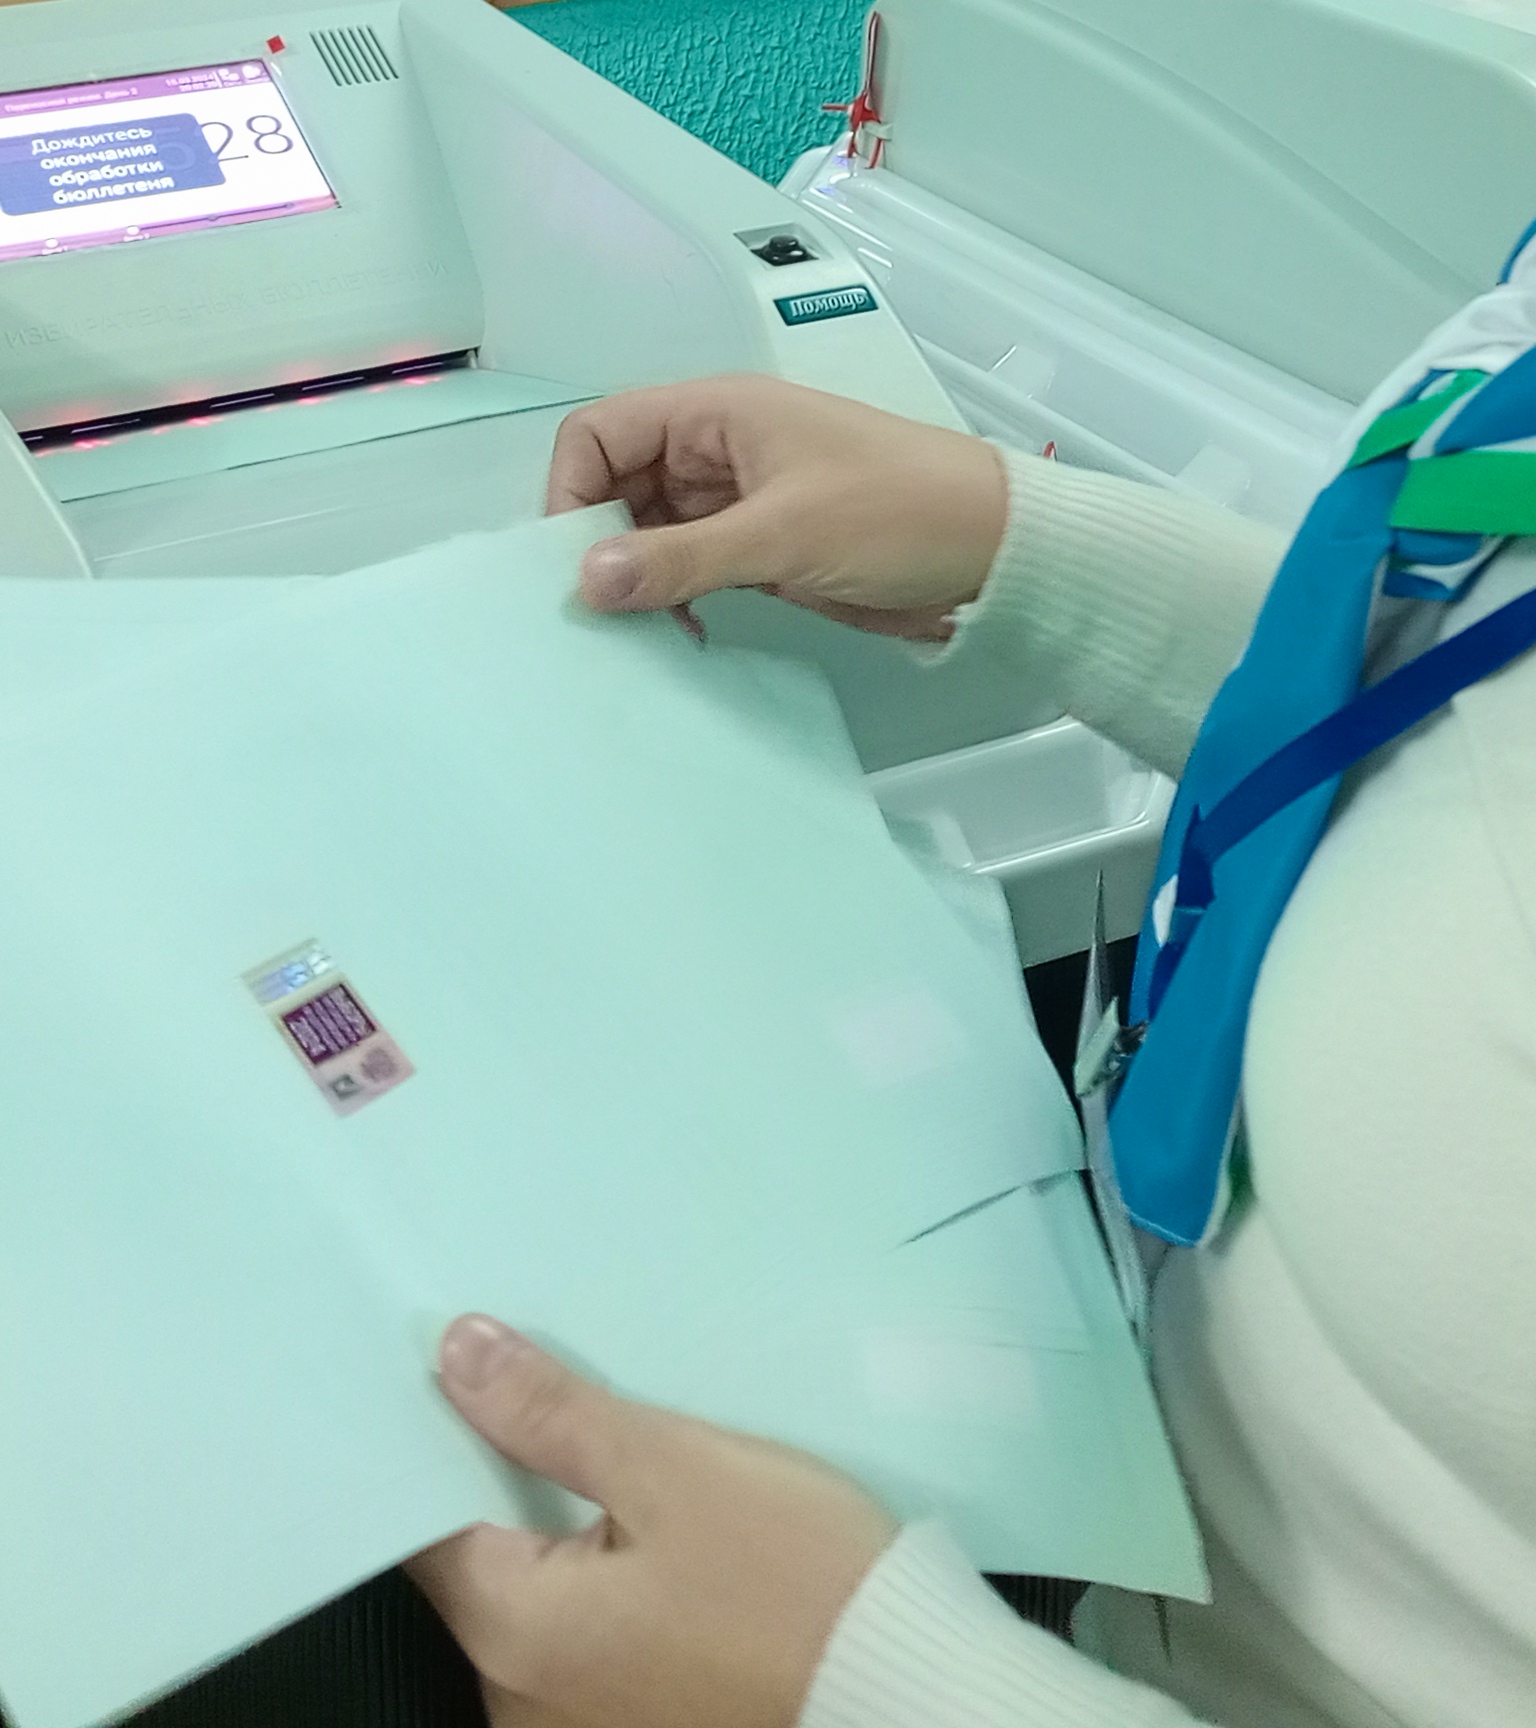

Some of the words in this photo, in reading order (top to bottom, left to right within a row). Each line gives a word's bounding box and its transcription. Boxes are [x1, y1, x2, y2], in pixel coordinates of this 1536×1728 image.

[31, 123, 153, 157] Дождитесь
[39, 141, 158, 171] окончания
[47, 157, 165, 188] обработки
[51, 174, 175, 207] бюллетеня
[789, 292, 867, 317] Помощь
